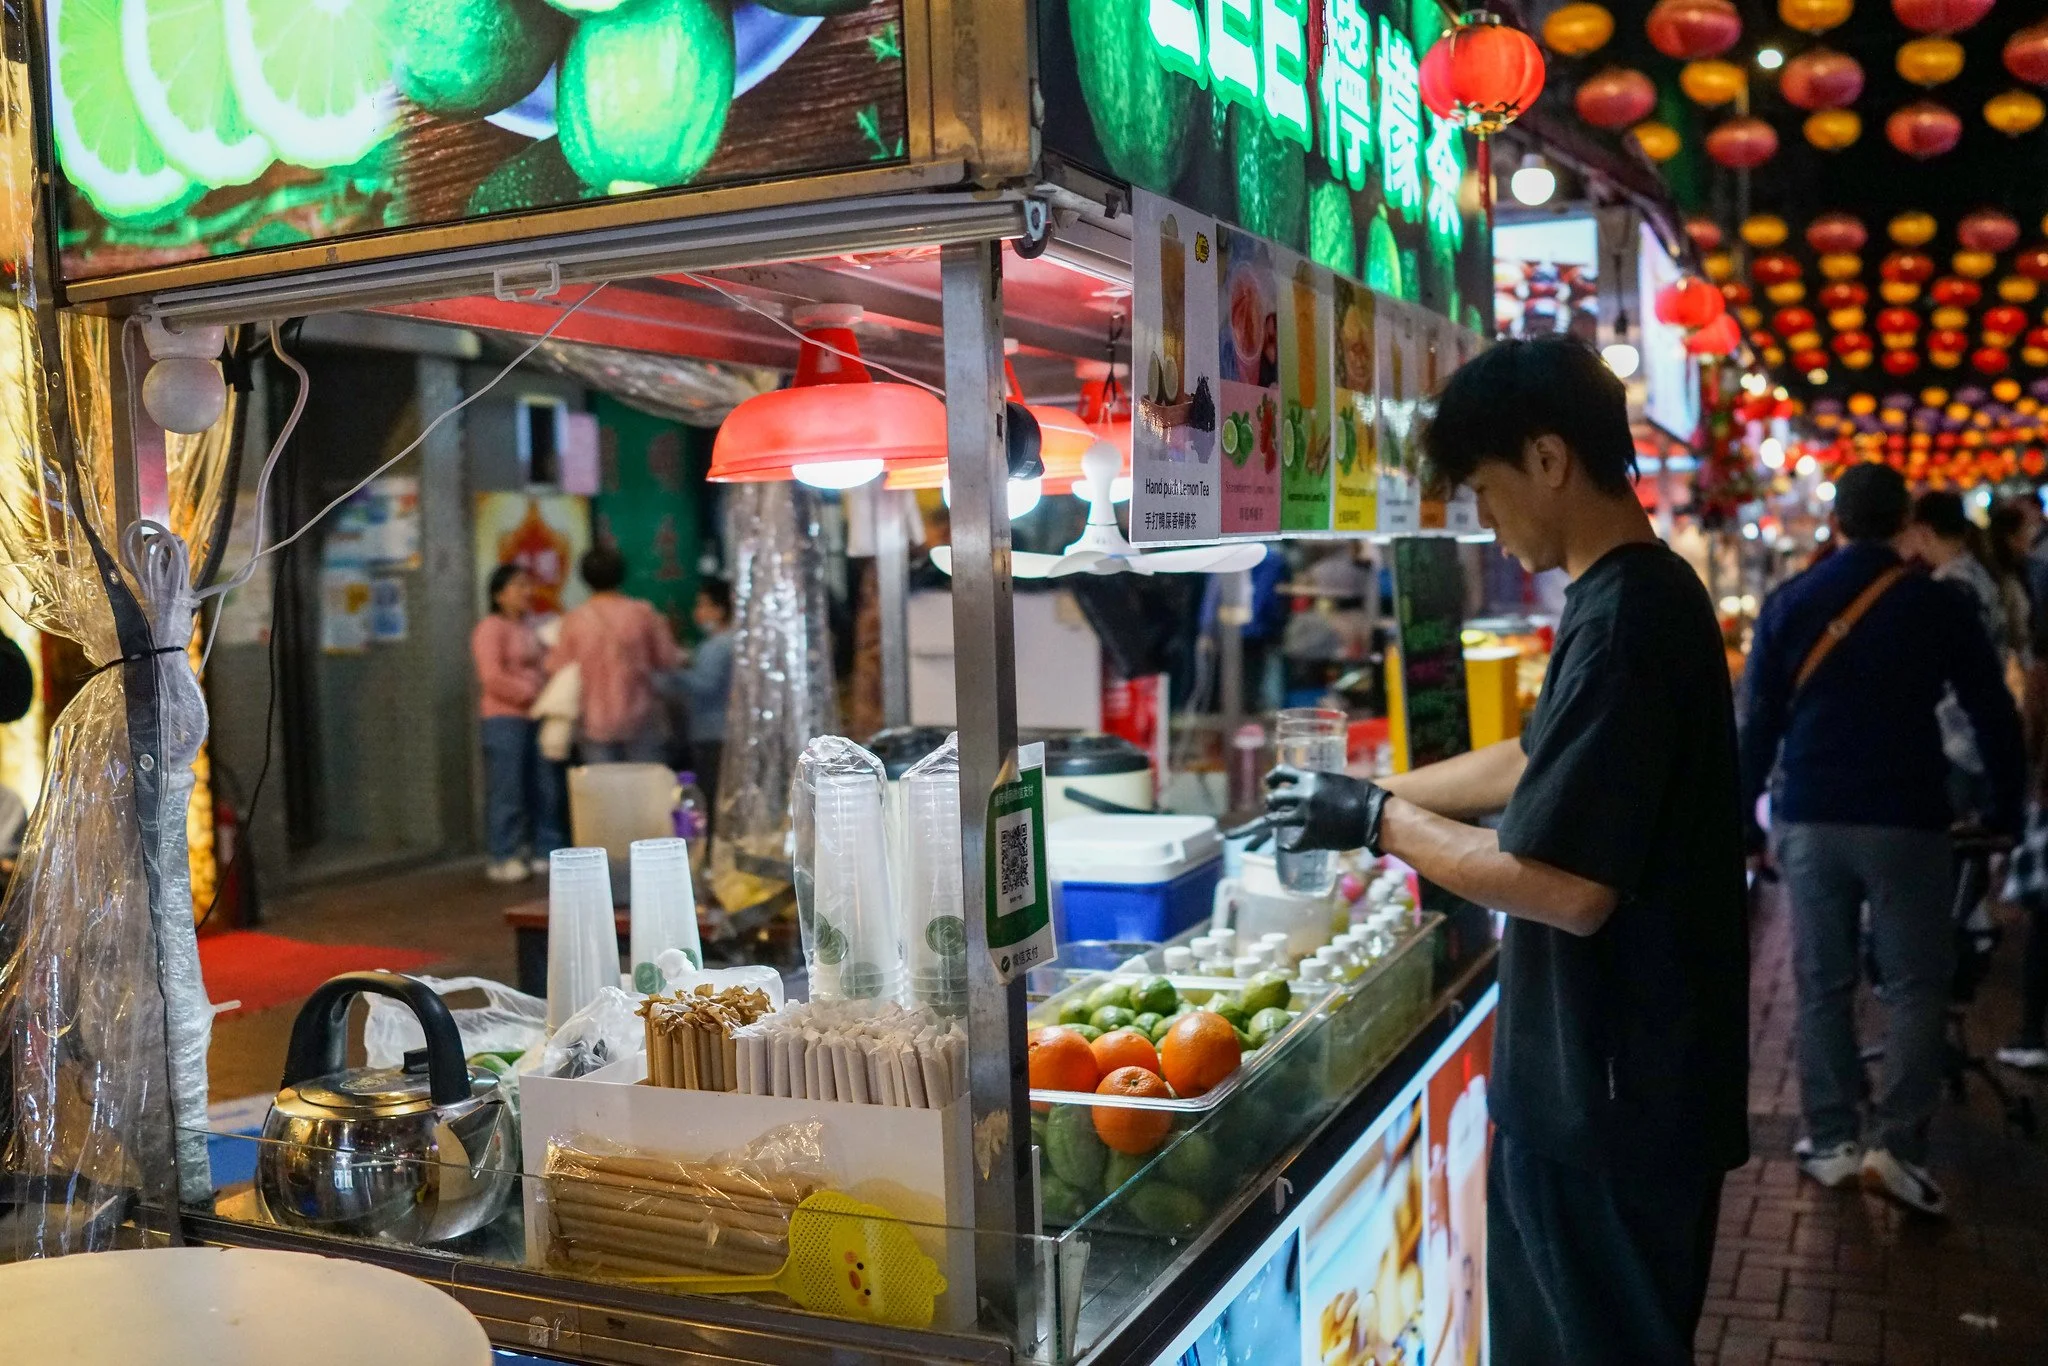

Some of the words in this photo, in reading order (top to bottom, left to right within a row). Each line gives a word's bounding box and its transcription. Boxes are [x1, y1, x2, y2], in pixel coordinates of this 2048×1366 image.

[1145, 478, 1163, 494] Hand
[1179, 480, 1199, 496] Lemon
[1199, 481, 1210, 497] Tea
